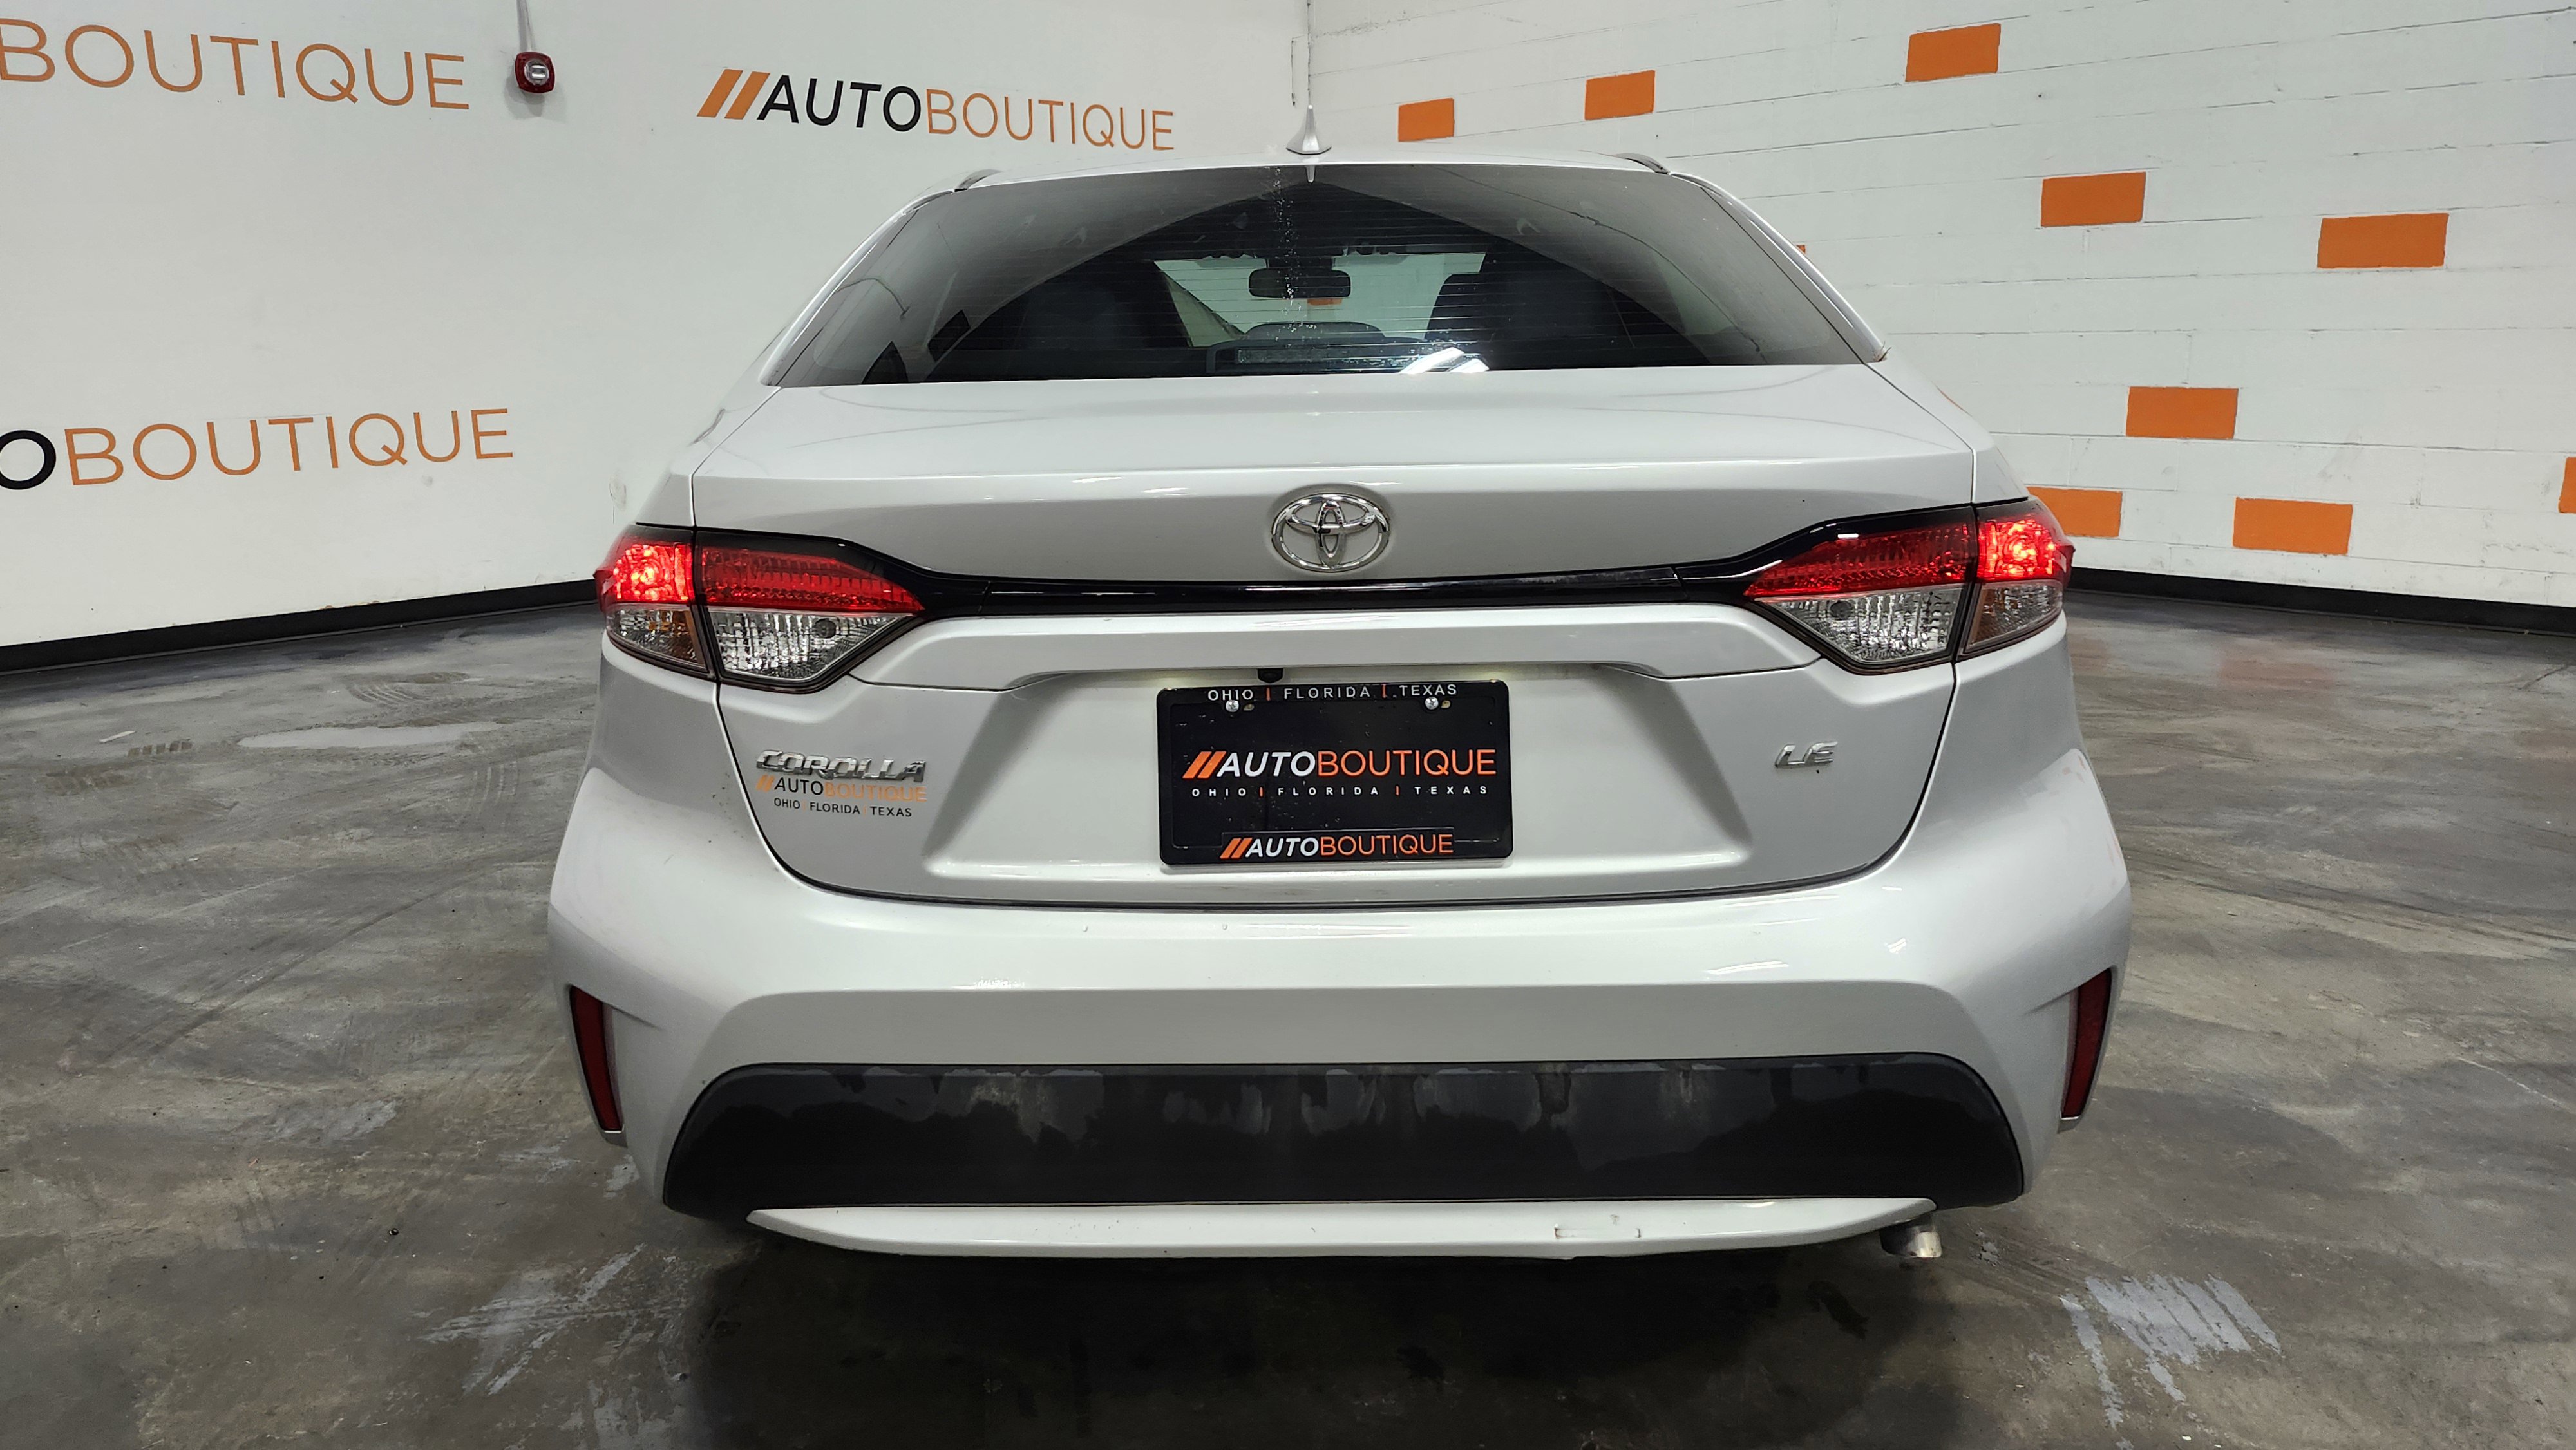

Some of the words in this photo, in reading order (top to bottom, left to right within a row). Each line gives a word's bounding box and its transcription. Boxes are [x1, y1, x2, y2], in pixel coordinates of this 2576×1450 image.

[0, 17, 469, 110] BOUTIQUE
[756, 74, 1175, 151] AUTOBOUTIQUE
[1208, 689, 1254, 701] OHIO
[1283, 686, 1371, 700] FLORIDA
[1399, 684, 1457, 697] TEXAS
[756, 749, 927, 782] COROLLA
[1217, 748, 1497, 778] AUTOBOUTIQUE
[1774, 741, 1838, 768] LE
[774, 777, 927, 803] AUTOBOUTIQUE
[1191, 787, 1248, 796] OHIO
[1278, 786, 1379, 796] FLORIDA
[1414, 785, 1488, 795] TEXAS
[773, 797, 800, 809] OHIO
[810, 802, 860, 814] FLORIDA
[870, 806, 912, 817] TEXAS
[1244, 833, 1454, 859] AUTOBOUTIQUE
